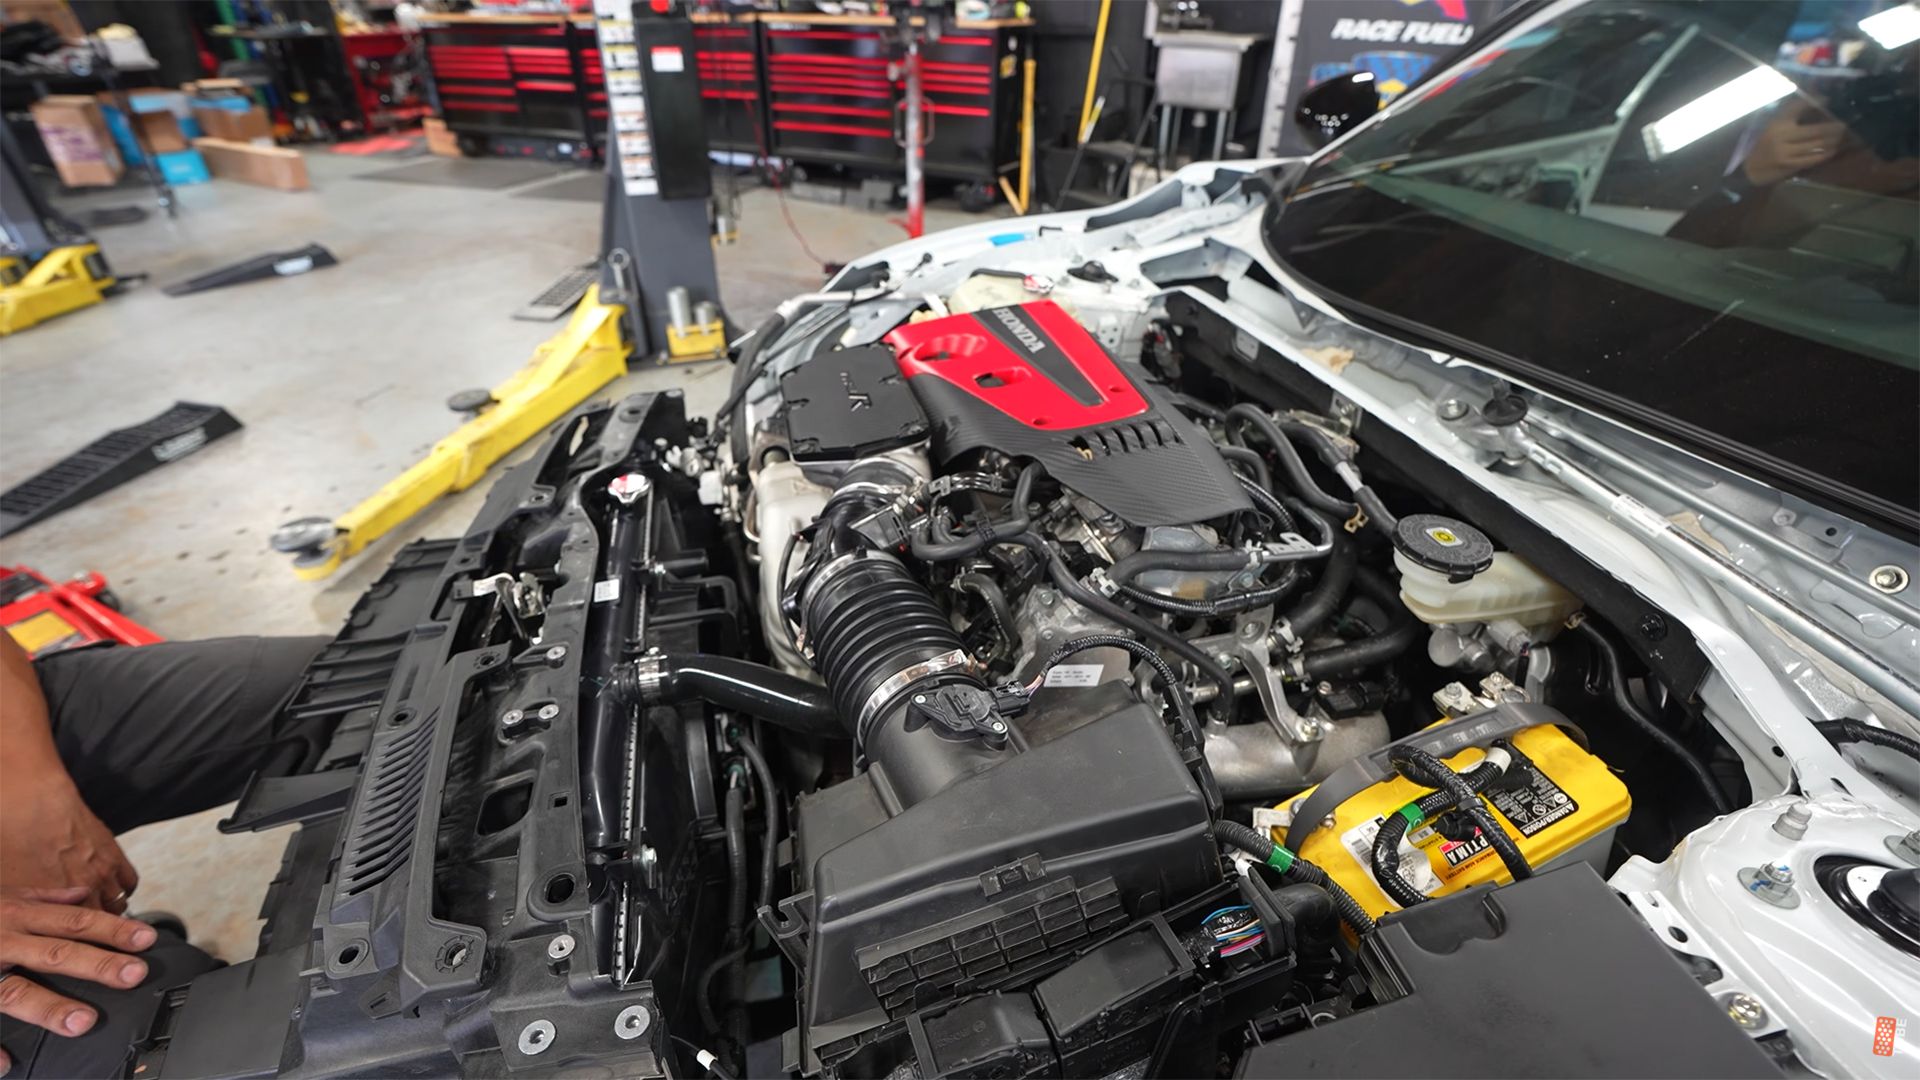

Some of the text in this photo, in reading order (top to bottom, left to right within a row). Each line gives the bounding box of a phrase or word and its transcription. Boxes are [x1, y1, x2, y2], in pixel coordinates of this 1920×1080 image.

[1331, 18, 1404, 42] RACE
[992, 307, 1046, 354] HONDA
[1446, 834, 1490, 864] PTIMA
